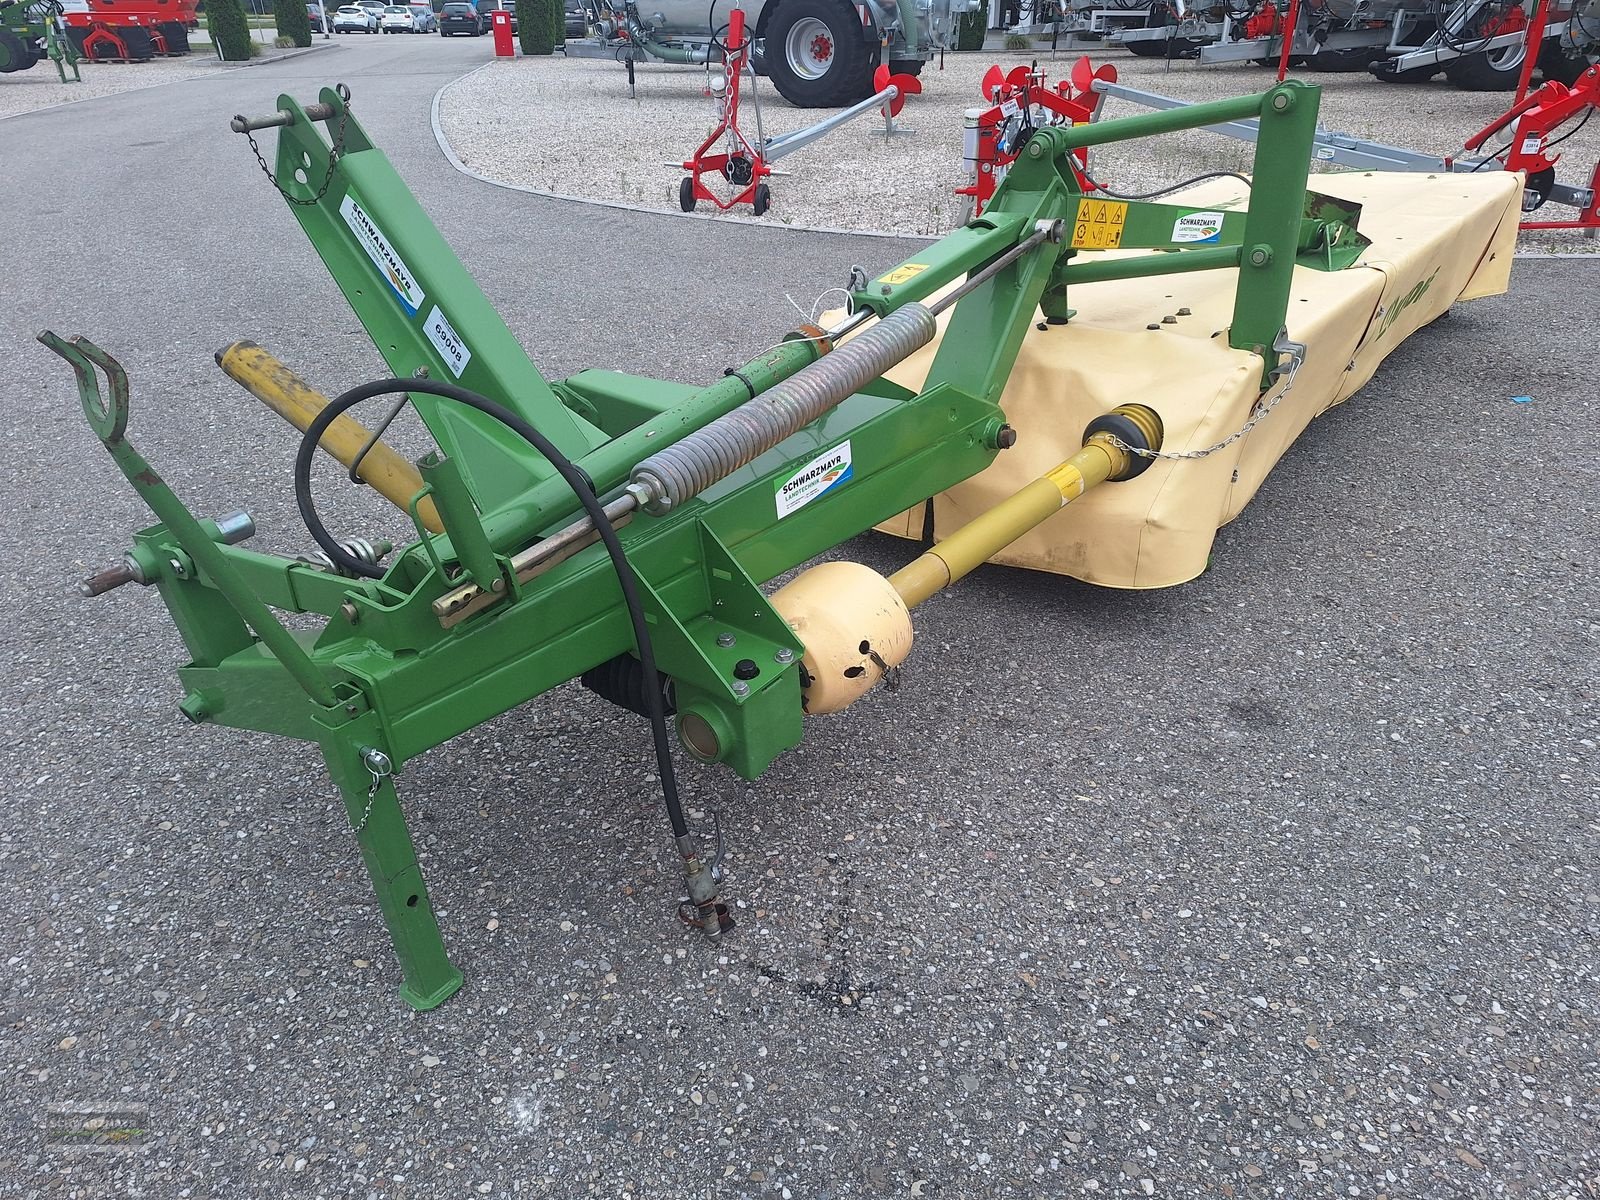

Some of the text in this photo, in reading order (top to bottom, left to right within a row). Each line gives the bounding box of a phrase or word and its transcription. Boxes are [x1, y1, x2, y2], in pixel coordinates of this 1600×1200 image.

[351, 212, 386, 263] LANDTECHNIK
[1179, 218, 1217, 226] SCHWARZMAYR
[351, 202, 412, 290] SCHWARZMAYR
[435, 324, 462, 362] 69008
[783, 455, 841, 494] SCHWARZMAYR
[785, 478, 820, 501] LANDTECHNIK
